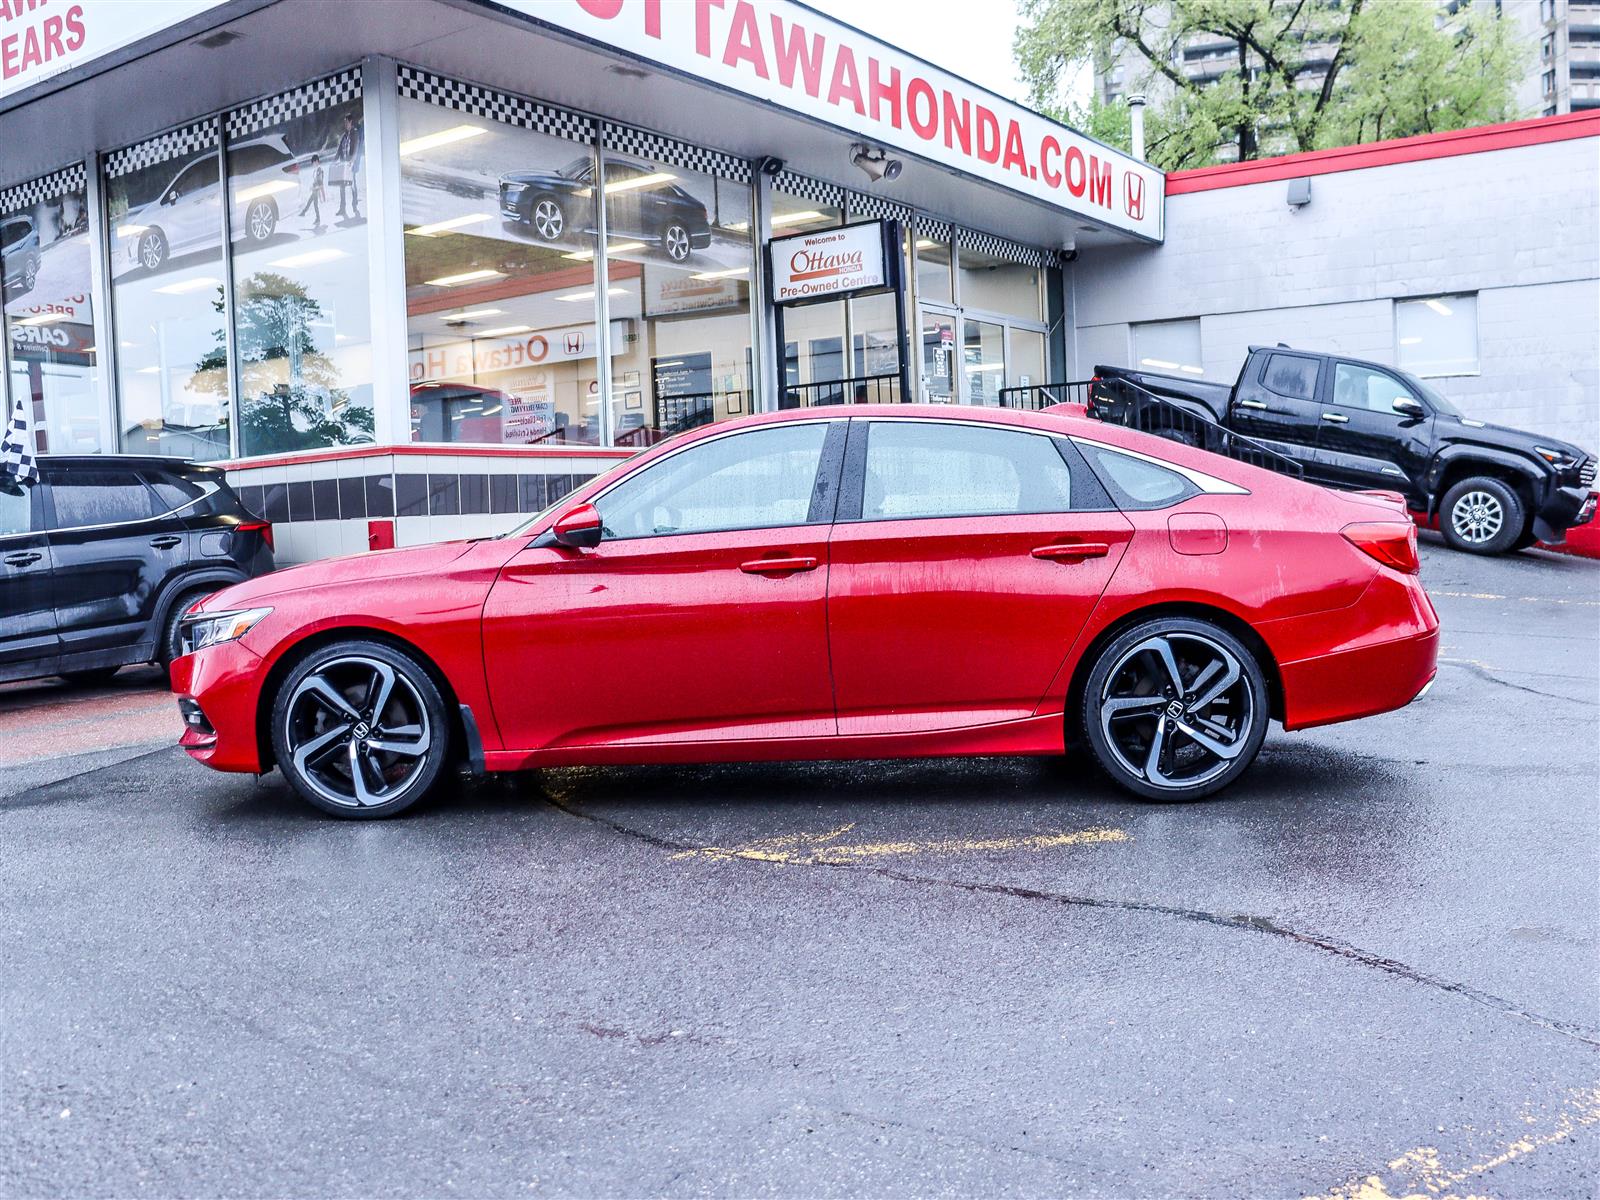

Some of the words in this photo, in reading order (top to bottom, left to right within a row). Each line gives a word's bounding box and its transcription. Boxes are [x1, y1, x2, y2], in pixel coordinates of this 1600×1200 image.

[1, 5, 86, 80] EARS
[804, 236, 836, 246] Welcome
[790, 249, 863, 273] Ottawa
[780, 279, 839, 297] Pre-Owned
[841, 274, 879, 288] Centre
